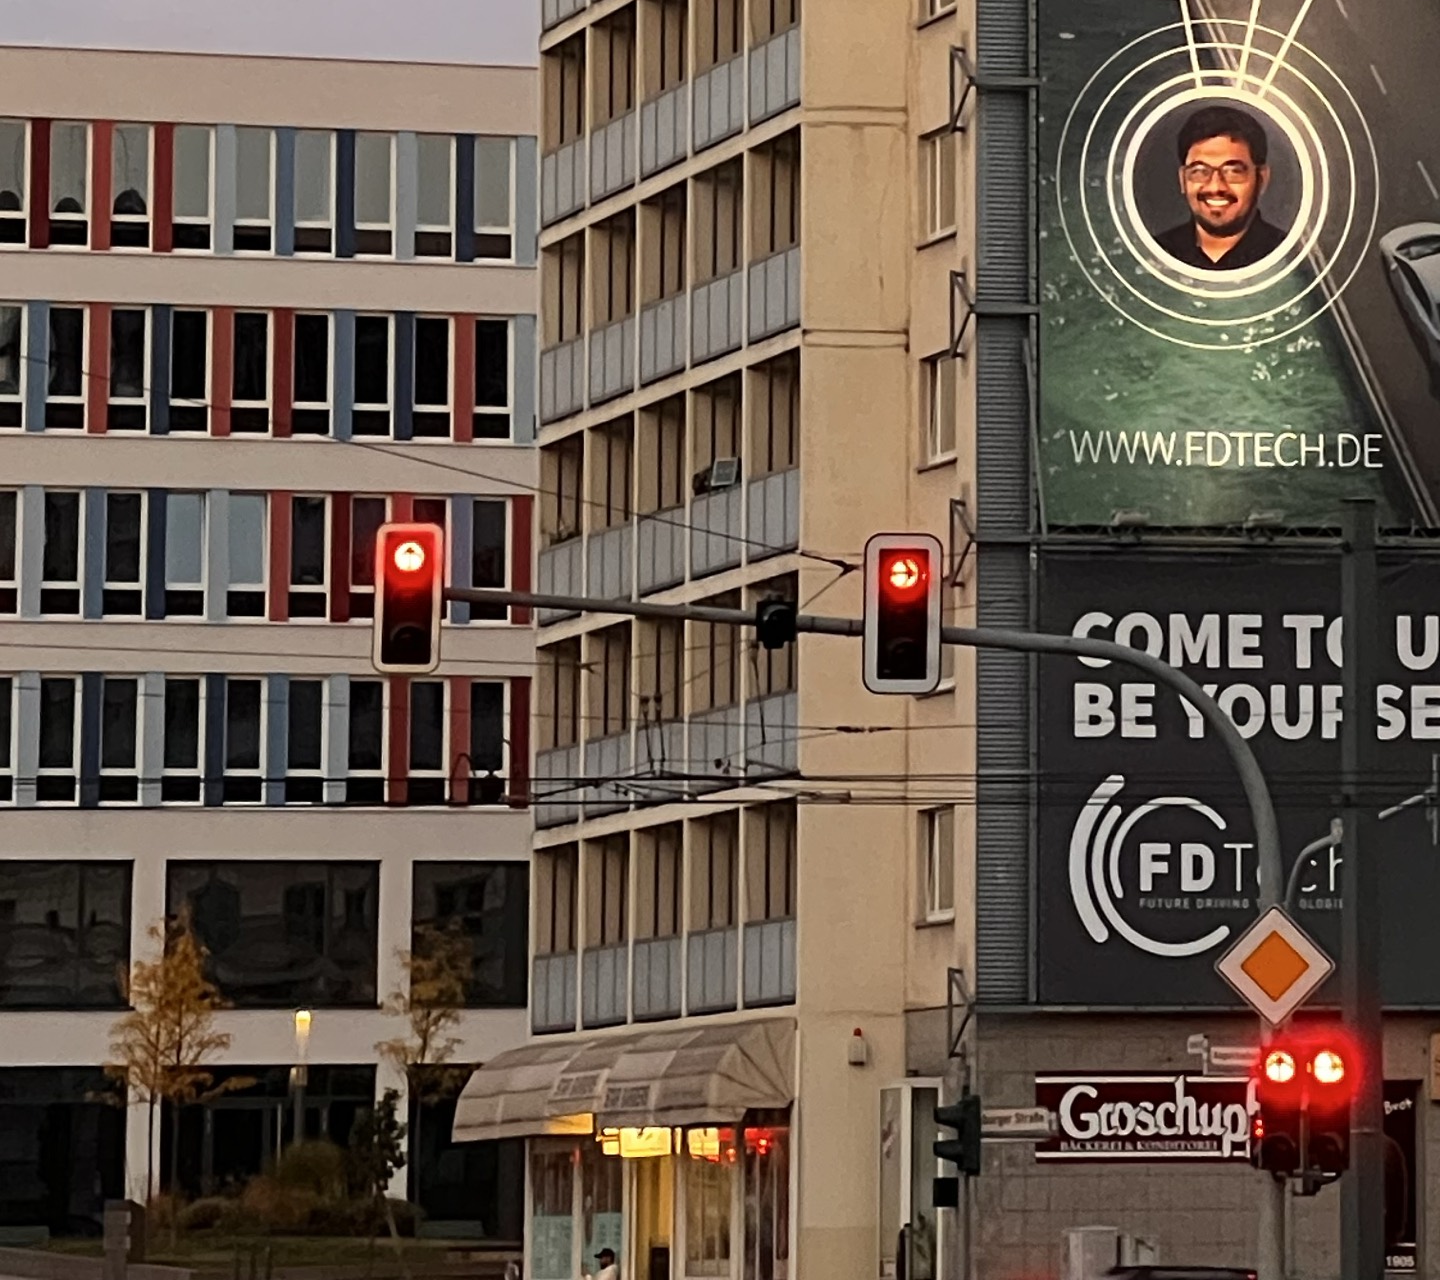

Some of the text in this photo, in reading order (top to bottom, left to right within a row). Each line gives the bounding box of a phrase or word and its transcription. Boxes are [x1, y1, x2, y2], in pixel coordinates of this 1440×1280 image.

[1069, 429, 1384, 468] WWW.FDTECH.DE
[1072, 612, 1264, 669] COME
[1074, 683, 1157, 738] BE
[1139, 898, 1190, 909] FUTURE
[1196, 898, 1249, 909] DRIVING
